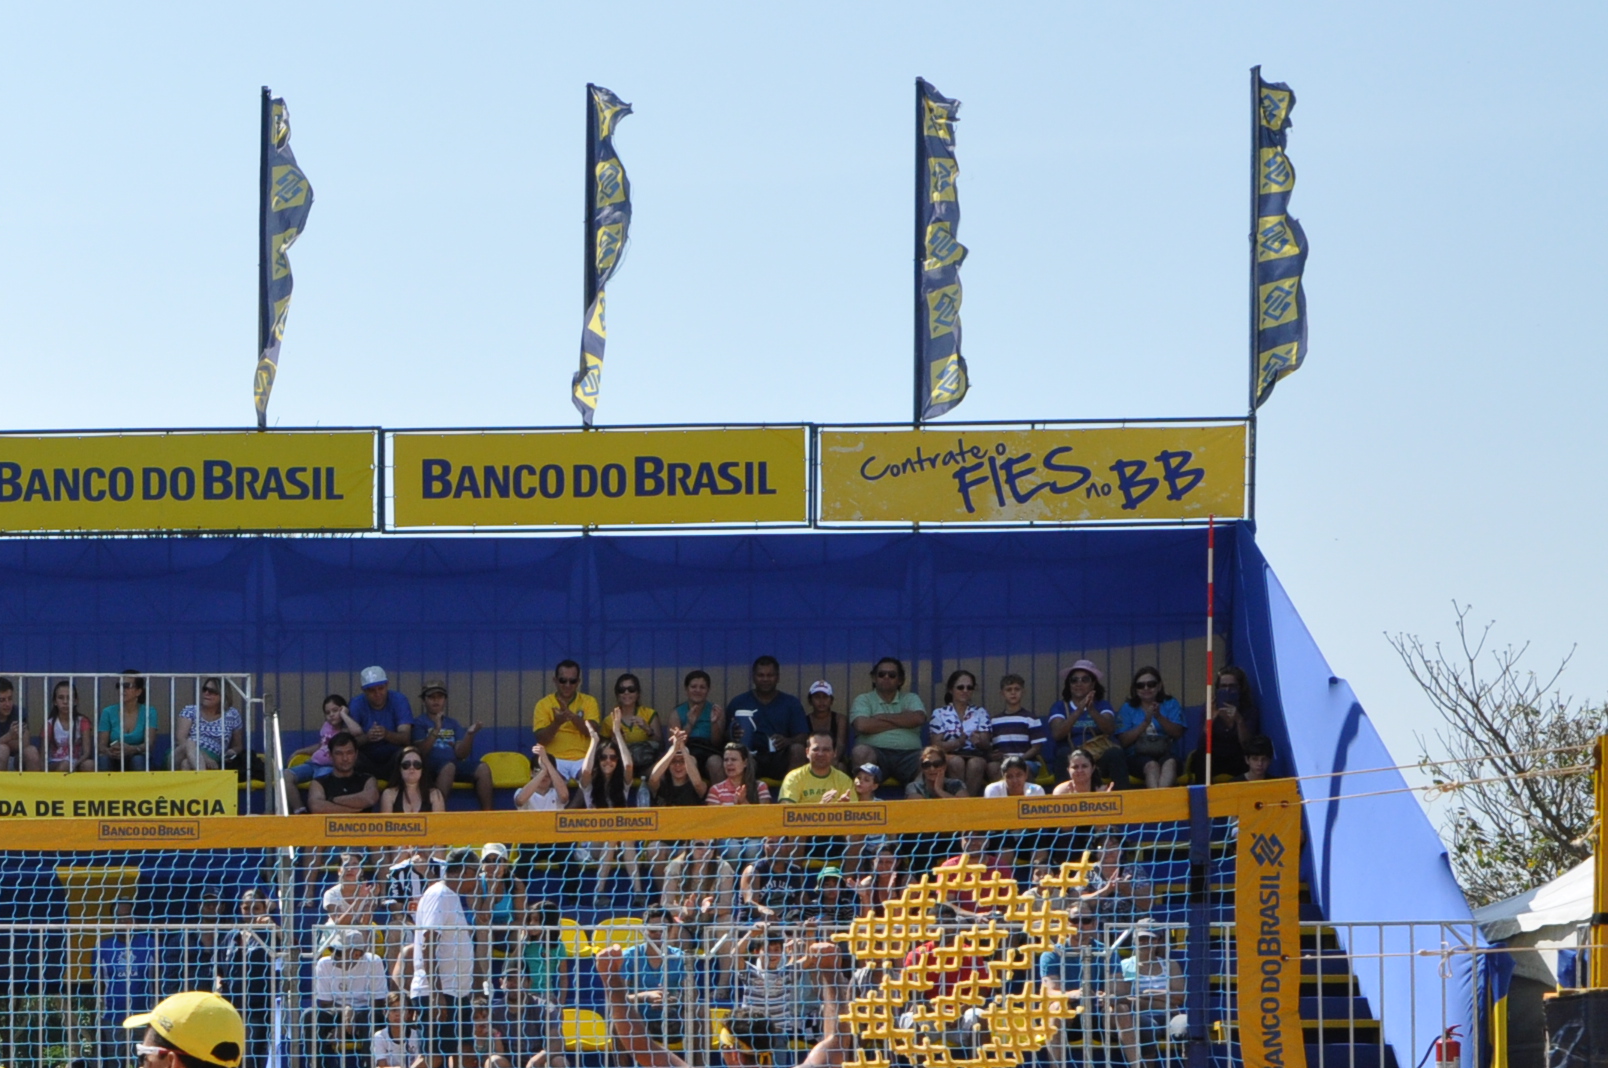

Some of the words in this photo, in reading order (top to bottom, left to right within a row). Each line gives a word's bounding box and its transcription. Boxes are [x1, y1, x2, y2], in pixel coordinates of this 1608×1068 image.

[860, 438, 988, 481] Contrate
[995, 442, 1007, 456] o
[142, 466, 196, 501] DO
[202, 459, 344, 501] BRASIL
[421, 458, 565, 499] BANCO
[572, 463, 627, 498] DO
[634, 456, 777, 497] BRASIL
[952, 446, 1092, 513] FIES
[1085, 481, 1112, 499] no
[1109, 450, 1205, 510] BB
[35, 801, 65, 817] DE
[73, 796, 225, 817] EMERGÊNCIA
[786, 810, 827, 825] BANCO
[827, 812, 843, 824] DO
[844, 808, 884, 823] BRASIL
[1020, 801, 1061, 815] BANCO
[1061, 804, 1078, 813] DO
[1078, 799, 1119, 813] BRASIL
[101, 824, 140, 839] BANCO
[141, 827, 157, 838] DO
[157, 823, 196, 838] BRASIL
[327, 821, 367, 835] BANCO
[367, 824, 383, 834] DO
[383, 820, 423, 834] BRASIL
[558, 815, 598, 831] BANCO
[599, 818, 615, 830] DO
[615, 814, 655, 830] BRASIL
[1258, 871, 1282, 957] BRASIL
[1261, 959, 1282, 994] DO
